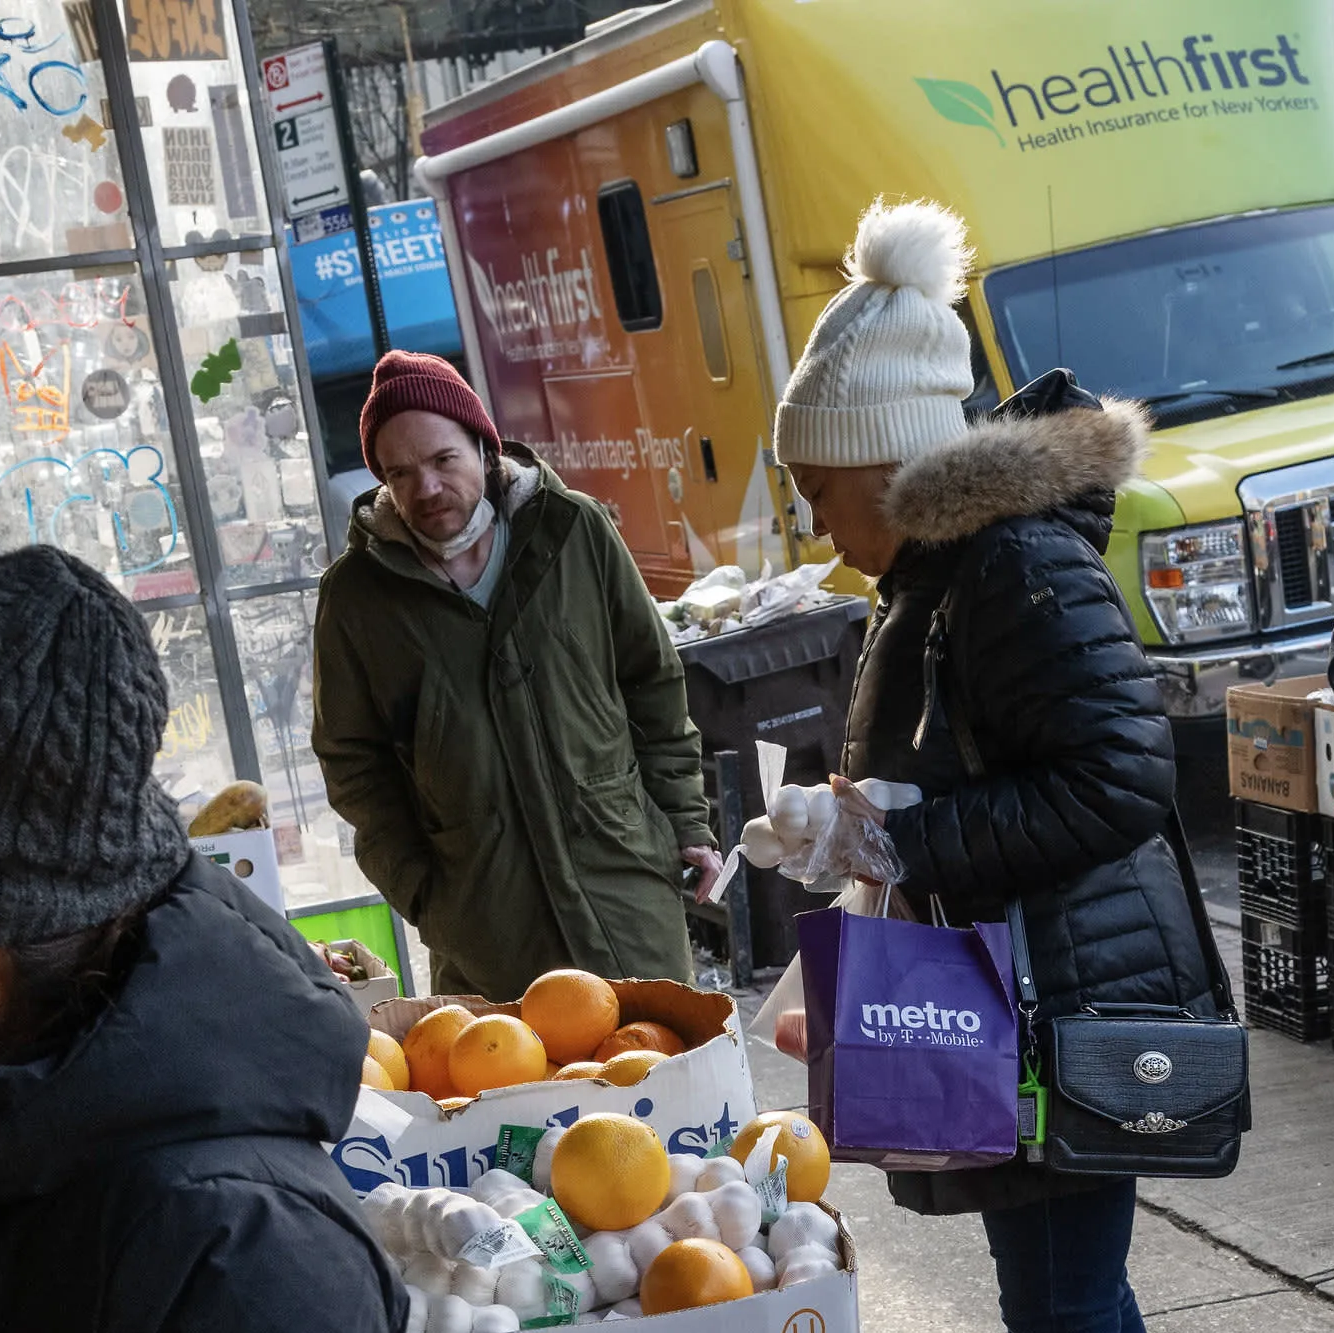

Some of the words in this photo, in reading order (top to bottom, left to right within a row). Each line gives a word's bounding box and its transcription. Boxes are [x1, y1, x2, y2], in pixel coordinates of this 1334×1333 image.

[991, 33, 1310, 127] healthfirst
[279, 121, 293, 148] 2
[1017, 124, 1085, 153] Health
[1087, 104, 1180, 137] Insurance
[1183, 98, 1209, 119] for
[1212, 95, 1253, 116] New
[1253, 94, 1319, 114] Yorkers
[489, 247, 602, 335] healthfirst
[560, 431, 637, 480] Advantage
[636, 427, 685, 470] Plans
[1240, 771, 1291, 798] BANANAS
[862, 1001, 981, 1033] metro
[878, 1028, 897, 1047] by
[546, 1205, 563, 1230] Jade
[561, 1226, 588, 1267] Elephant
